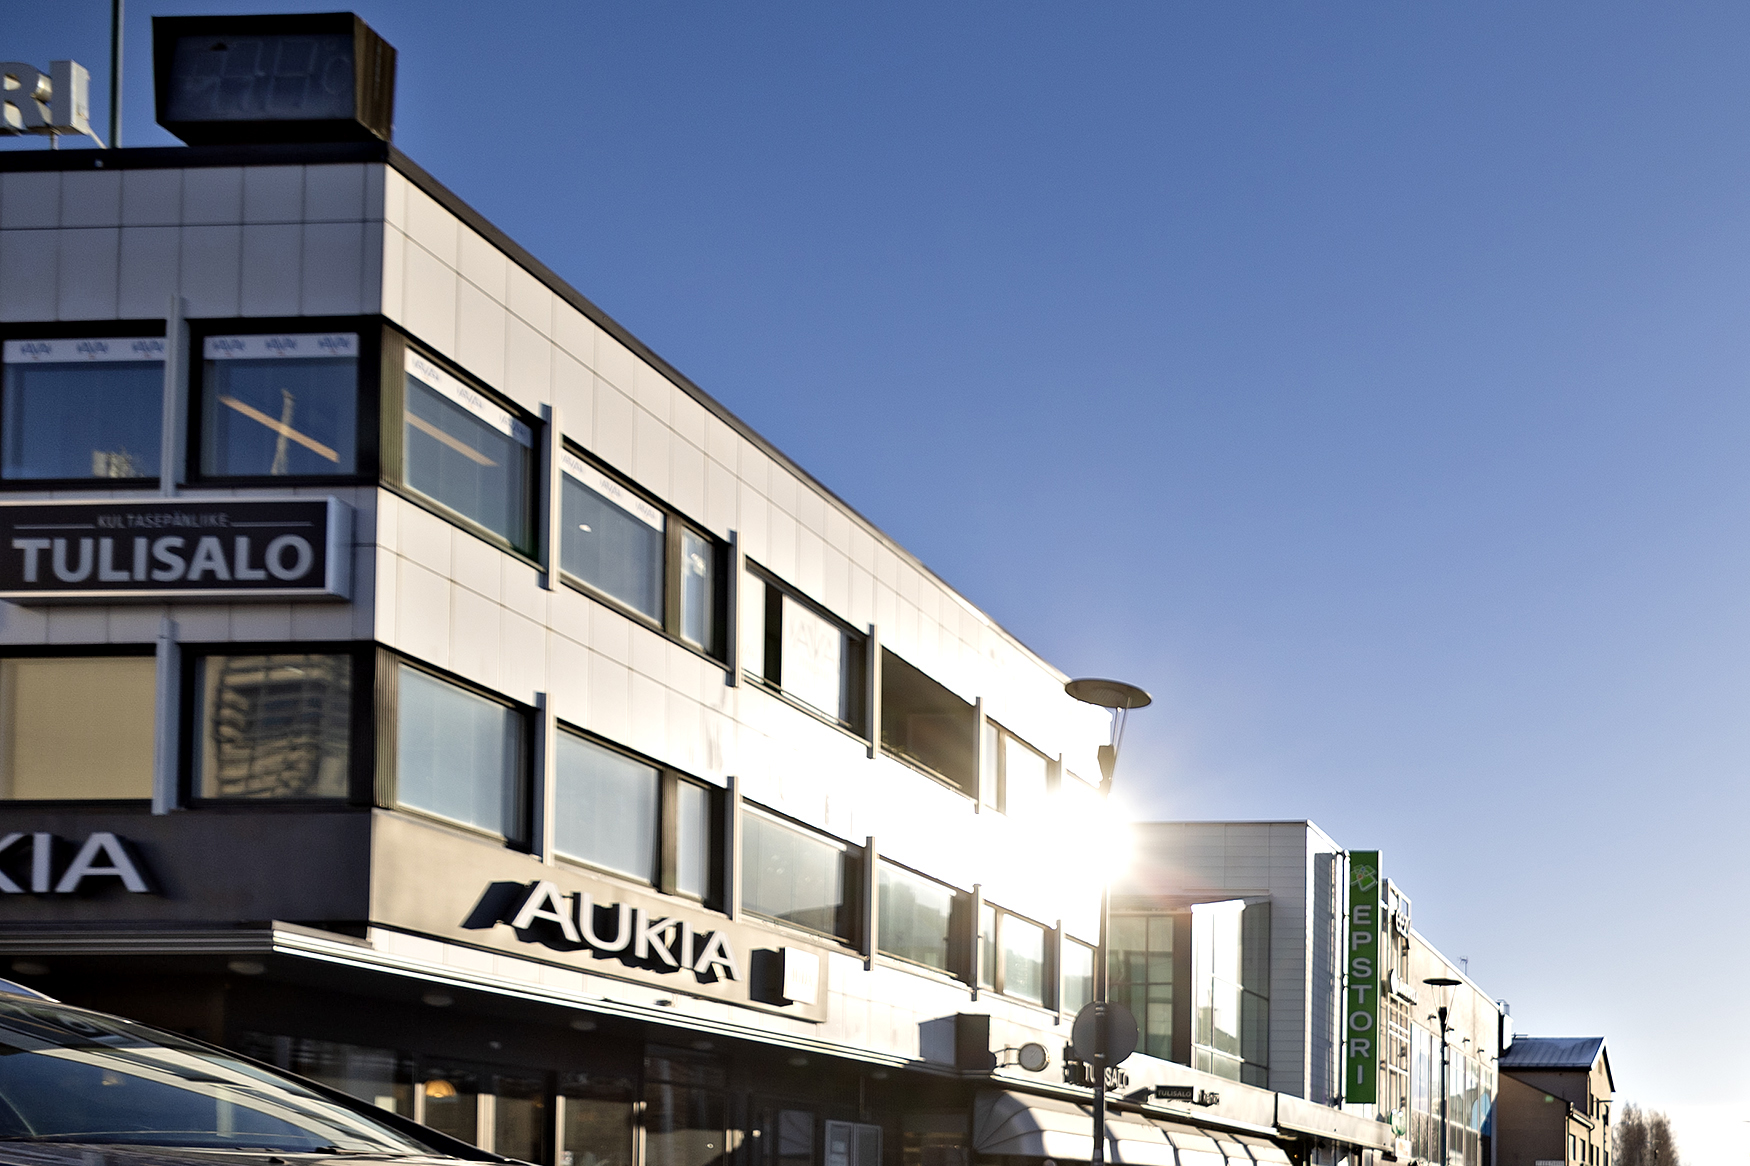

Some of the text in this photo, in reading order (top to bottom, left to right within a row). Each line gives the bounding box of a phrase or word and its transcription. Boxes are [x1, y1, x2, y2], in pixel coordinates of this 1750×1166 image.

[12, 533, 315, 583] TULISALO
[511, 879, 744, 983] AUKIA
[1350, 905, 1373, 1085] EPSTORI
[1083, 1061, 1129, 1089] TUSALO
[1157, 1090, 1191, 1098] TULISALO
